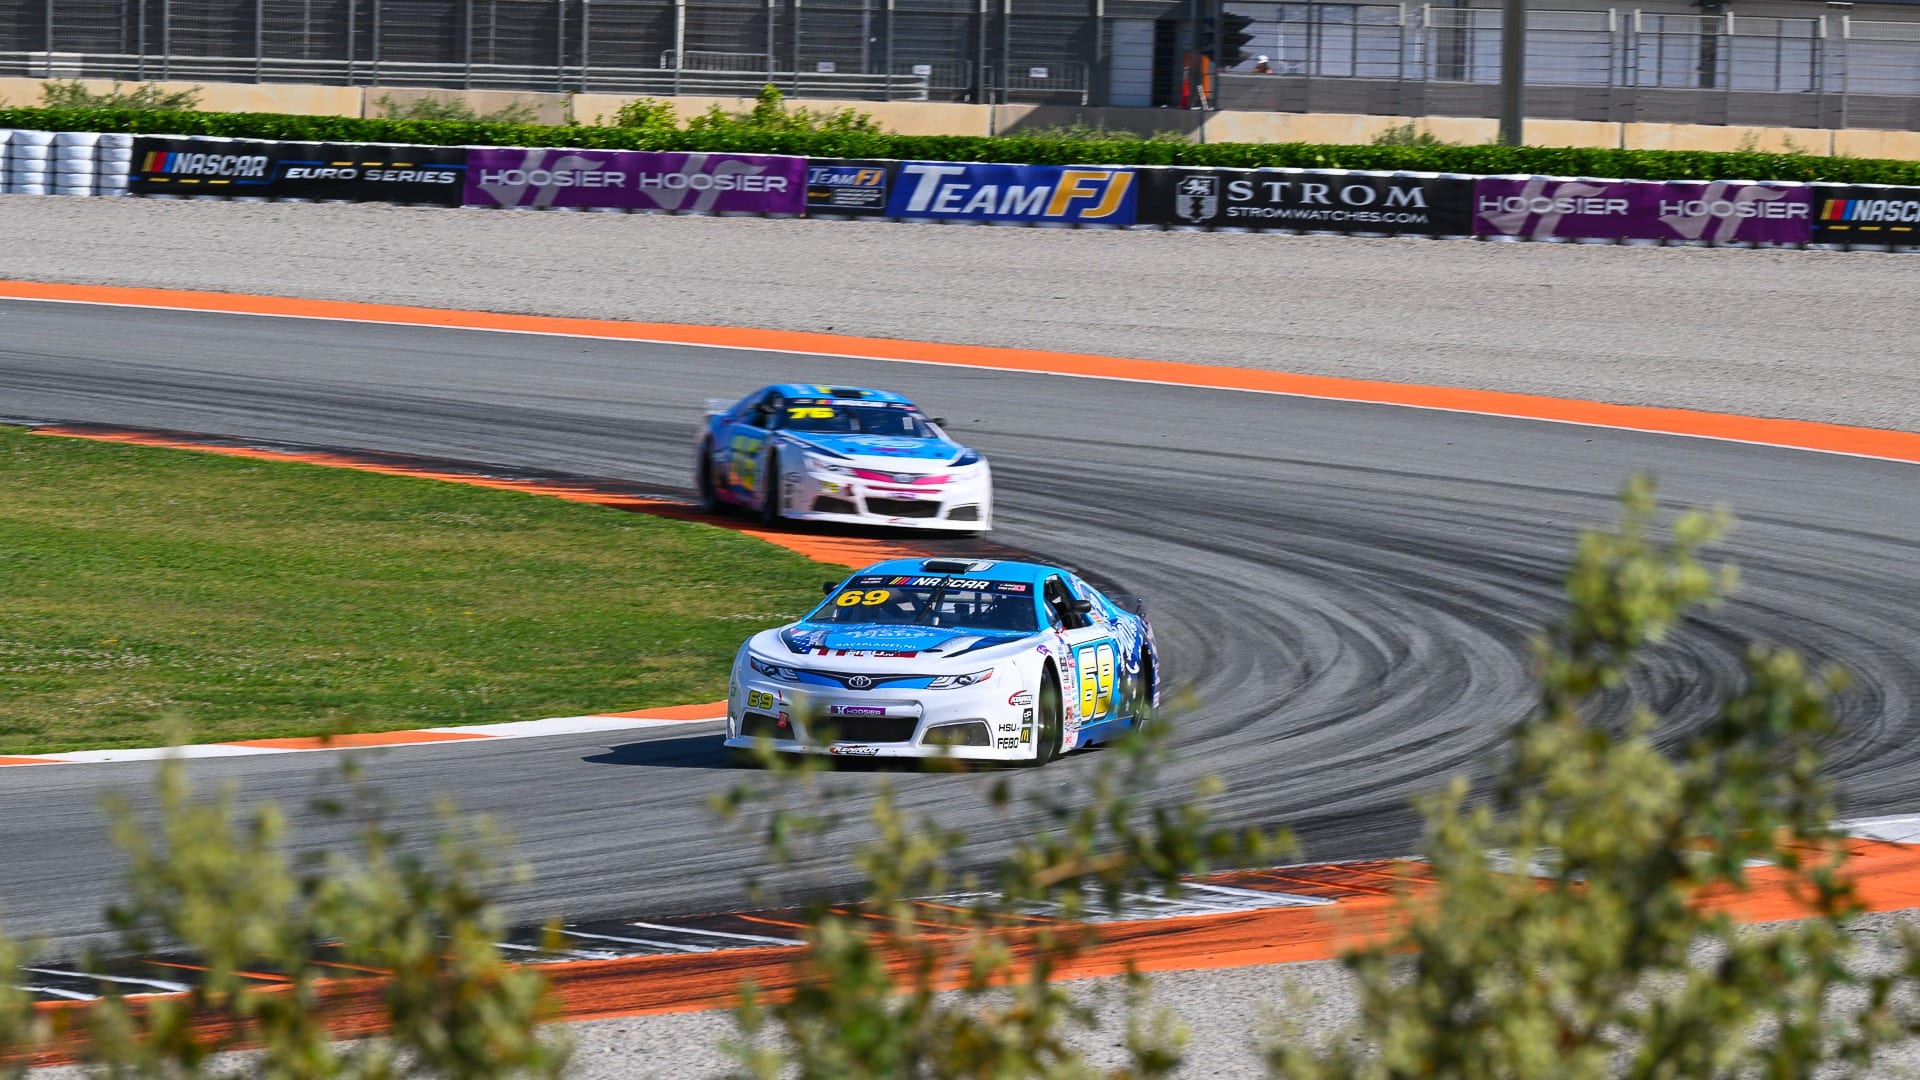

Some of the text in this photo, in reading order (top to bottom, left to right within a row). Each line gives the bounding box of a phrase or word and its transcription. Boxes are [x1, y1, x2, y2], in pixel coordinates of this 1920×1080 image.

[172, 151, 268, 177] NASCAR
[284, 167, 457, 184] EURO SERIES
[479, 168, 626, 188] HOOSIER
[639, 171, 789, 193] HOOSIER
[1226, 180, 1430, 208] STROM
[1226, 206, 1430, 224] STROMWATCHES.COM
[1478, 195, 1629, 216] HOOSIER
[1659, 199, 1810, 220] HOOSIER
[786, 407, 835, 419] 76
[836, 589, 891, 607] 69
[1078, 643, 1115, 721] 69
[748, 690, 774, 710] 69
